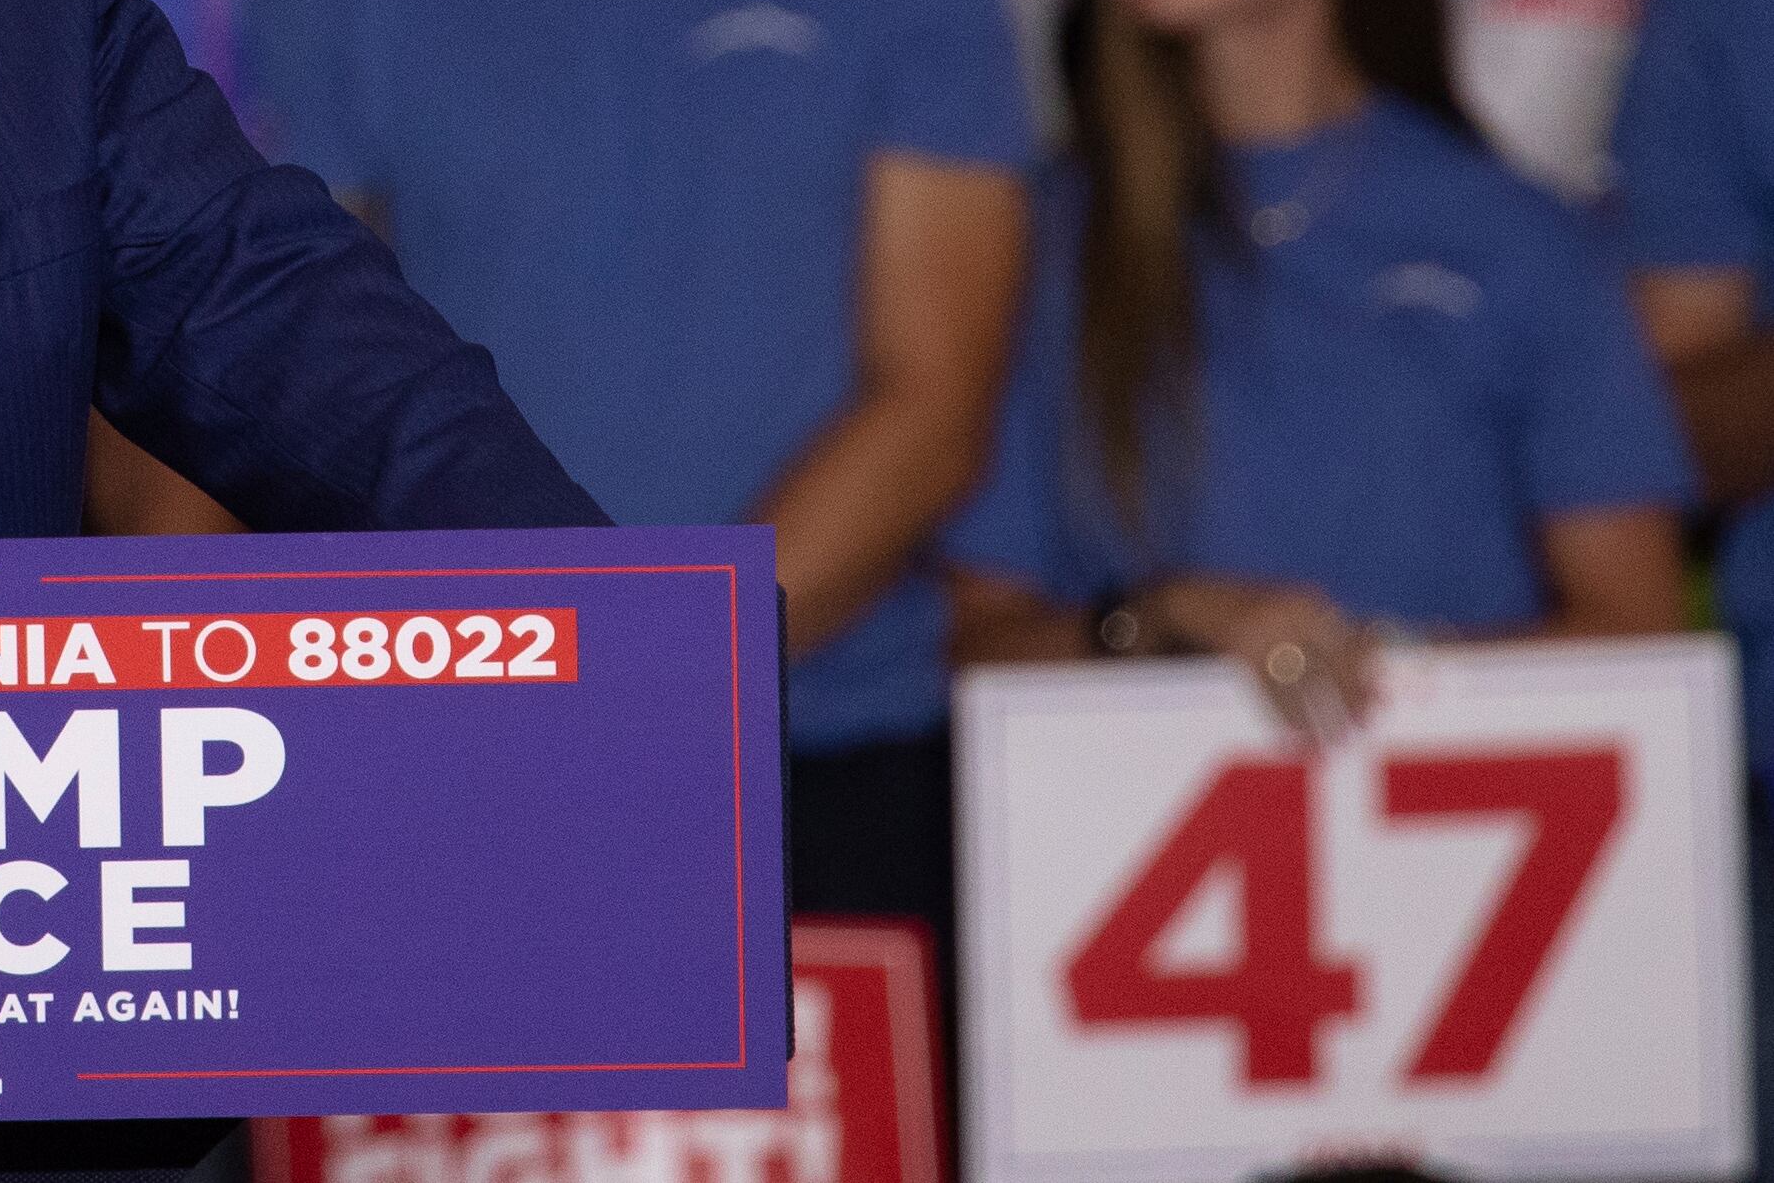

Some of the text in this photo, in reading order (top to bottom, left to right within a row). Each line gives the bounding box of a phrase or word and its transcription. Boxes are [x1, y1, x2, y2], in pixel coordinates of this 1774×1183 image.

[141, 619, 257, 683] TO
[288, 614, 557, 681] 88022
[1060, 740, 1634, 1094] 47
[72, 989, 239, 1023] AGAIN!
